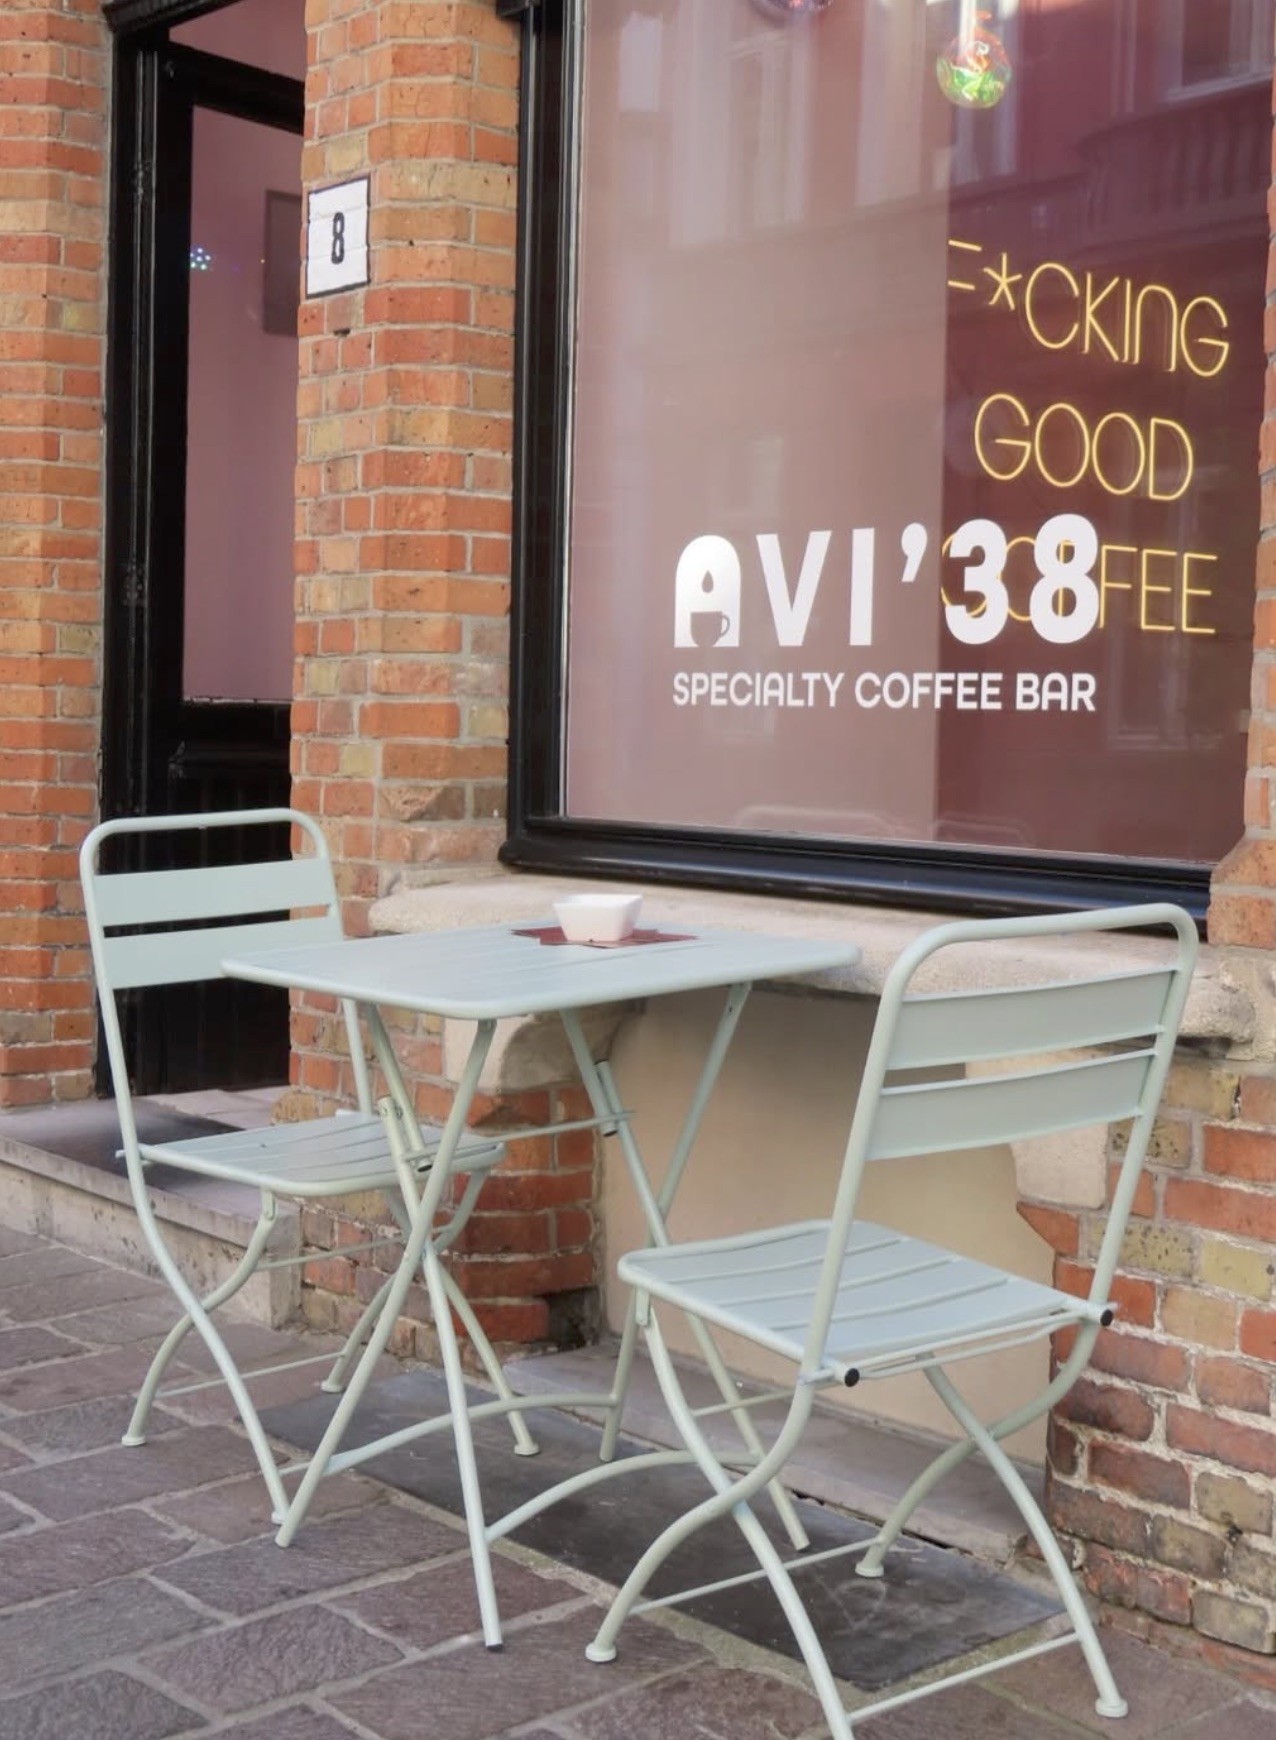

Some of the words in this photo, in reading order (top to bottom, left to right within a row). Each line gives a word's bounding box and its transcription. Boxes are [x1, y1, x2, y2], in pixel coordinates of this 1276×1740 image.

[331, 212, 345, 265] 8
[974, 393, 1193, 501] GOOD
[673, 671, 845, 707] SPECIALTY
[854, 671, 1004, 710] COFFEE
[1015, 672, 1097, 711] BAR
